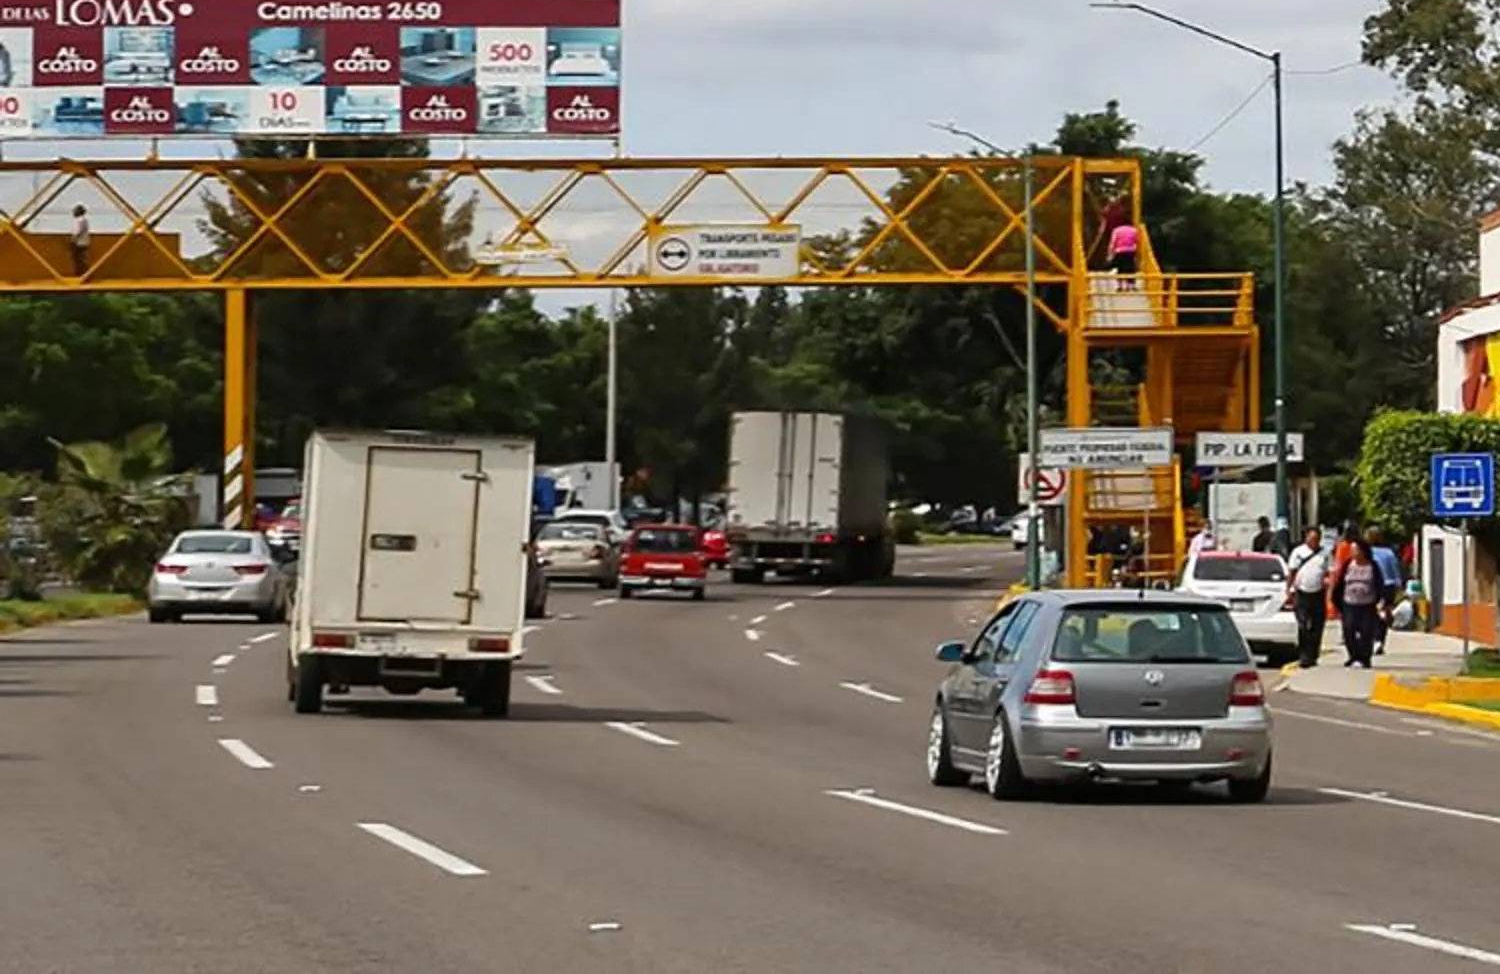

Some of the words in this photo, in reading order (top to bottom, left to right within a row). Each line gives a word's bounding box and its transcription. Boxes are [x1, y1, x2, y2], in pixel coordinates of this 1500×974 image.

[257, 1, 382, 20] Camelinas
[386, 2, 442, 20] 2650
[56, 47, 78, 57] AL
[199, 47, 221, 57] AL
[351, 47, 373, 57] AL
[490, 44, 533, 62] 500
[38, 59, 97, 73] COSTO
[180, 59, 239, 73] COSTO
[333, 59, 392, 72] COSTO
[129, 97, 152, 107] AL
[269, 93, 297, 110] 10
[426, 95, 450, 107] AL
[571, 95, 593, 107] AL
[111, 110, 170, 122] COSTO
[409, 108, 467, 121] COSTO
[553, 108, 610, 121] COSTO
[1233, 443, 1252, 457] LA
